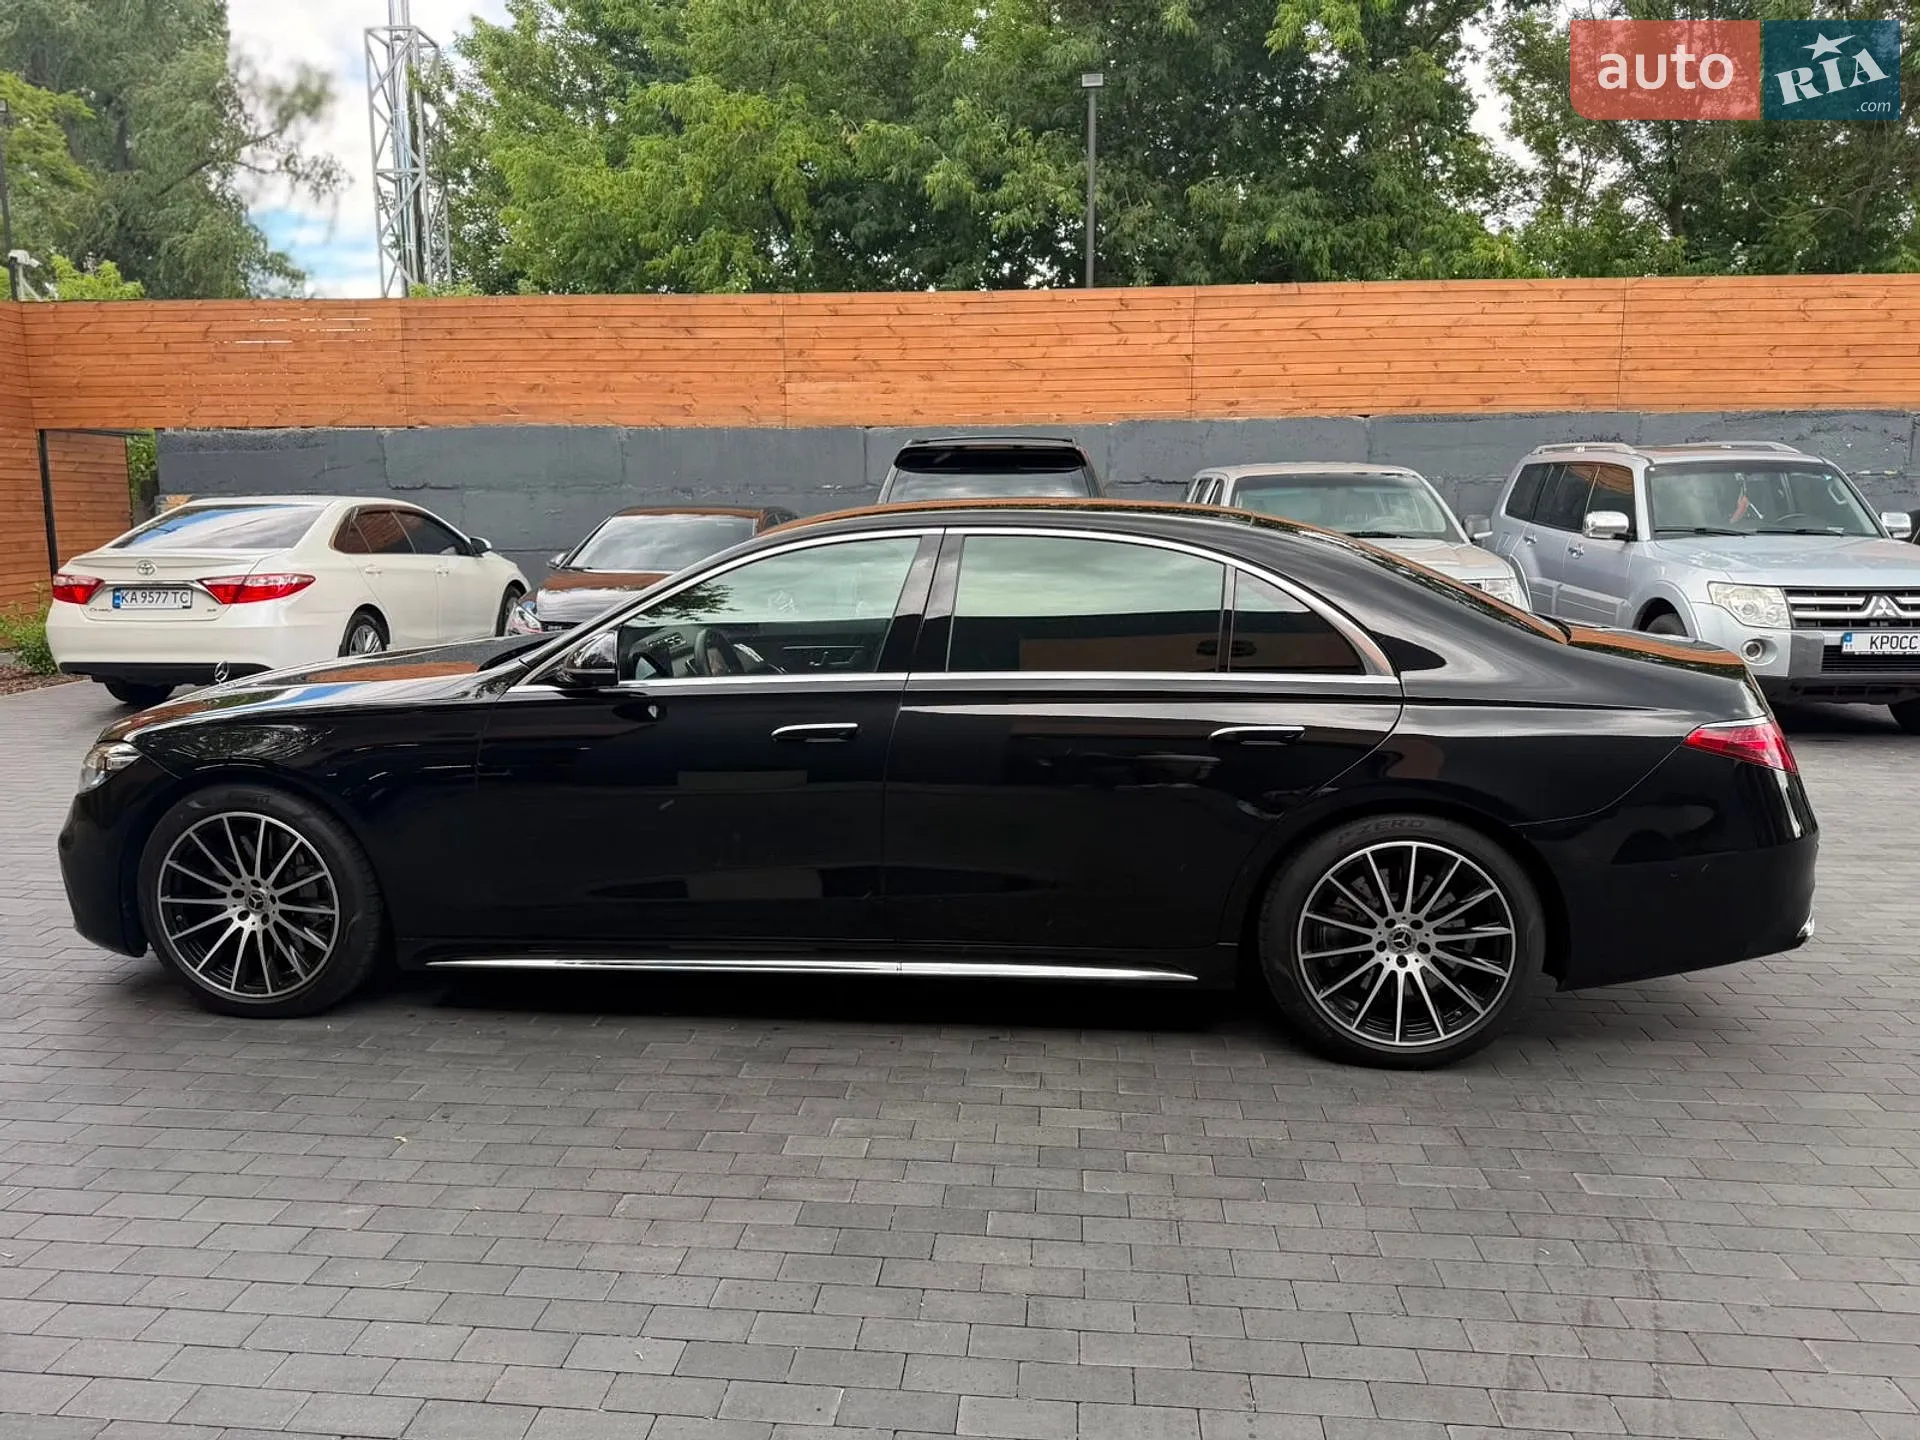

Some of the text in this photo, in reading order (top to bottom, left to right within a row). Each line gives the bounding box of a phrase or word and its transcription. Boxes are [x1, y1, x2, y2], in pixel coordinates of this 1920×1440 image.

[121, 591, 189, 604] KA 9577 TC
